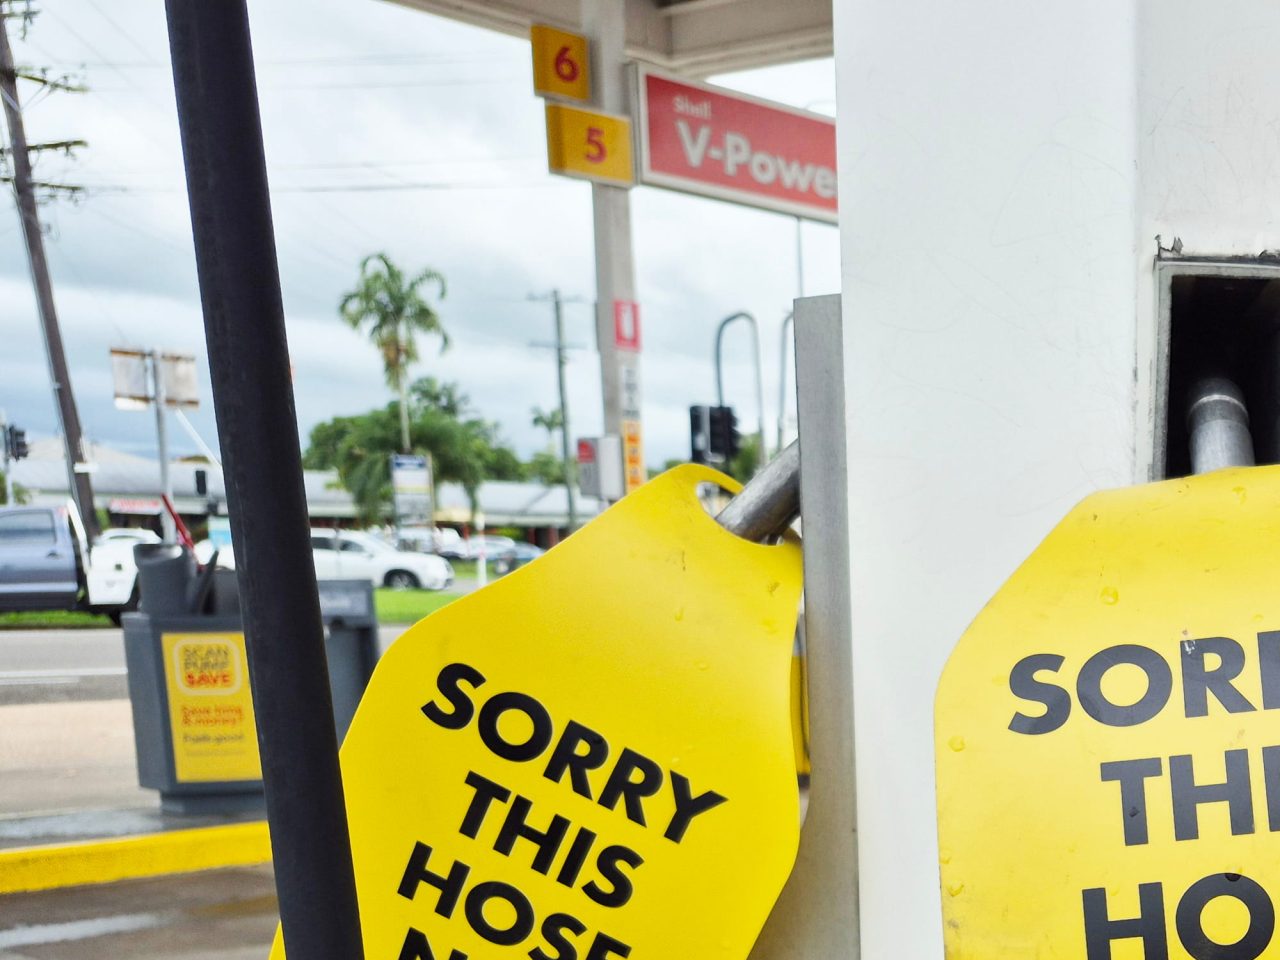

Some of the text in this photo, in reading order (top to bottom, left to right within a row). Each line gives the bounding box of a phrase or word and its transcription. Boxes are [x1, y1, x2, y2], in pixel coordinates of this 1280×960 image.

[554, 47, 579, 83] 6
[673, 95, 712, 119] Shell
[584, 127, 607, 163] 5
[675, 119, 837, 199] V-Powe
[420, 662, 729, 844] SORRY
[458, 771, 645, 908] THIS
